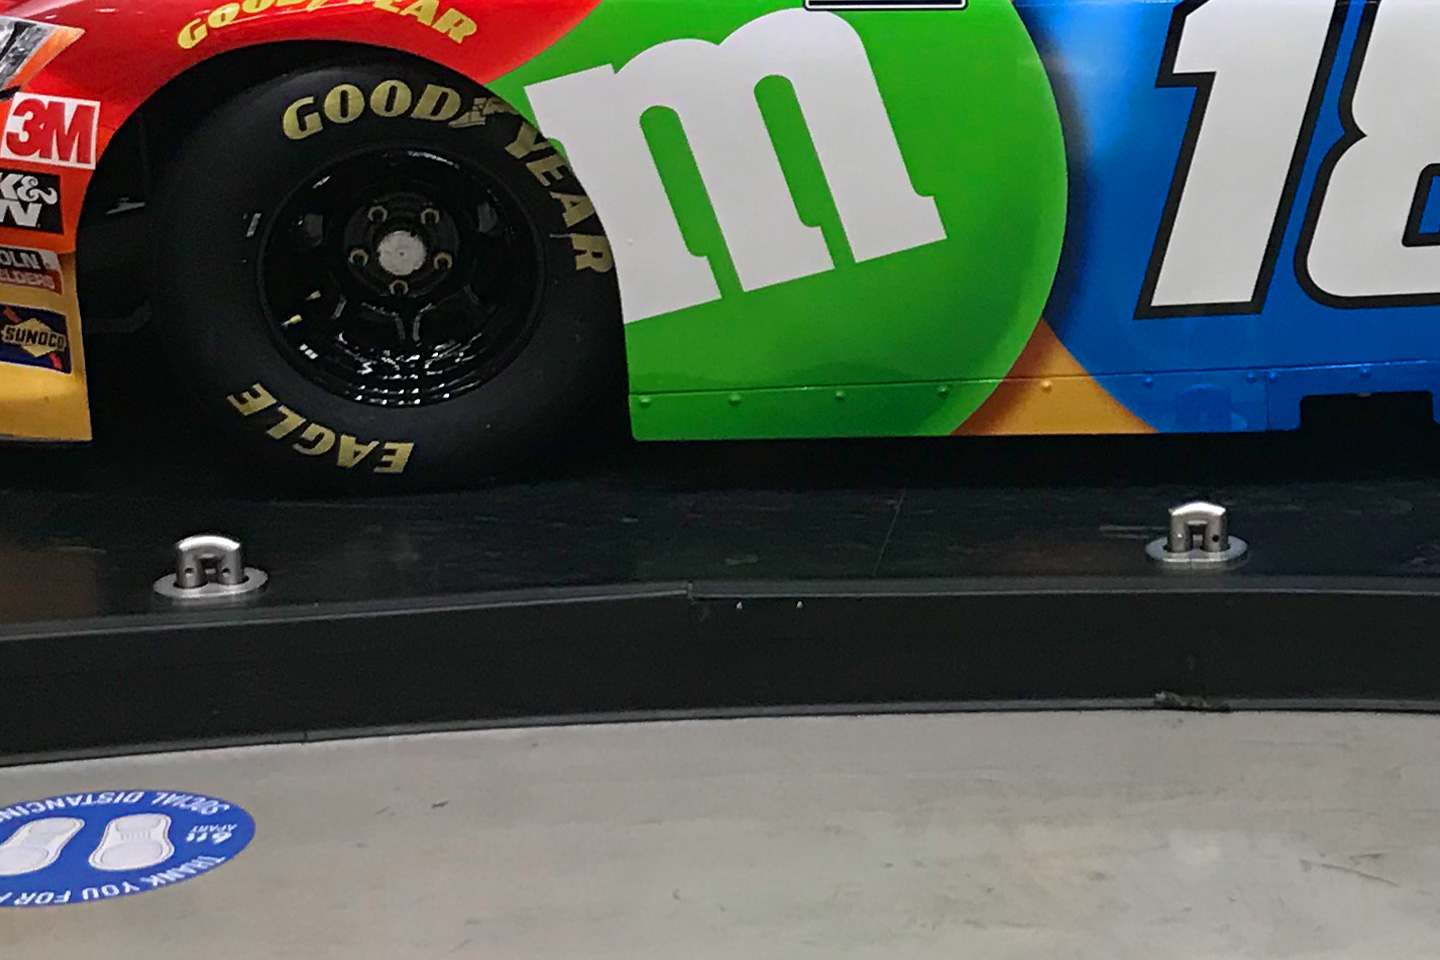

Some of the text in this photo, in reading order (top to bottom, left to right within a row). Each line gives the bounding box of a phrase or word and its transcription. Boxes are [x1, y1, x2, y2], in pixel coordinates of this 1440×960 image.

[6, 98, 94, 164] 3M
[523, 7, 948, 325] m
[5, 323, 66, 351] SUNOCO
[226, 382, 415, 474] EAGLE
[0, 790, 231, 824] SOCIAL DISTANCIN
[188, 823, 238, 834] APART
[139, 855, 227, 887] THANK
[13, 890, 72, 906] FOR
[82, 880, 140, 901] YOU
